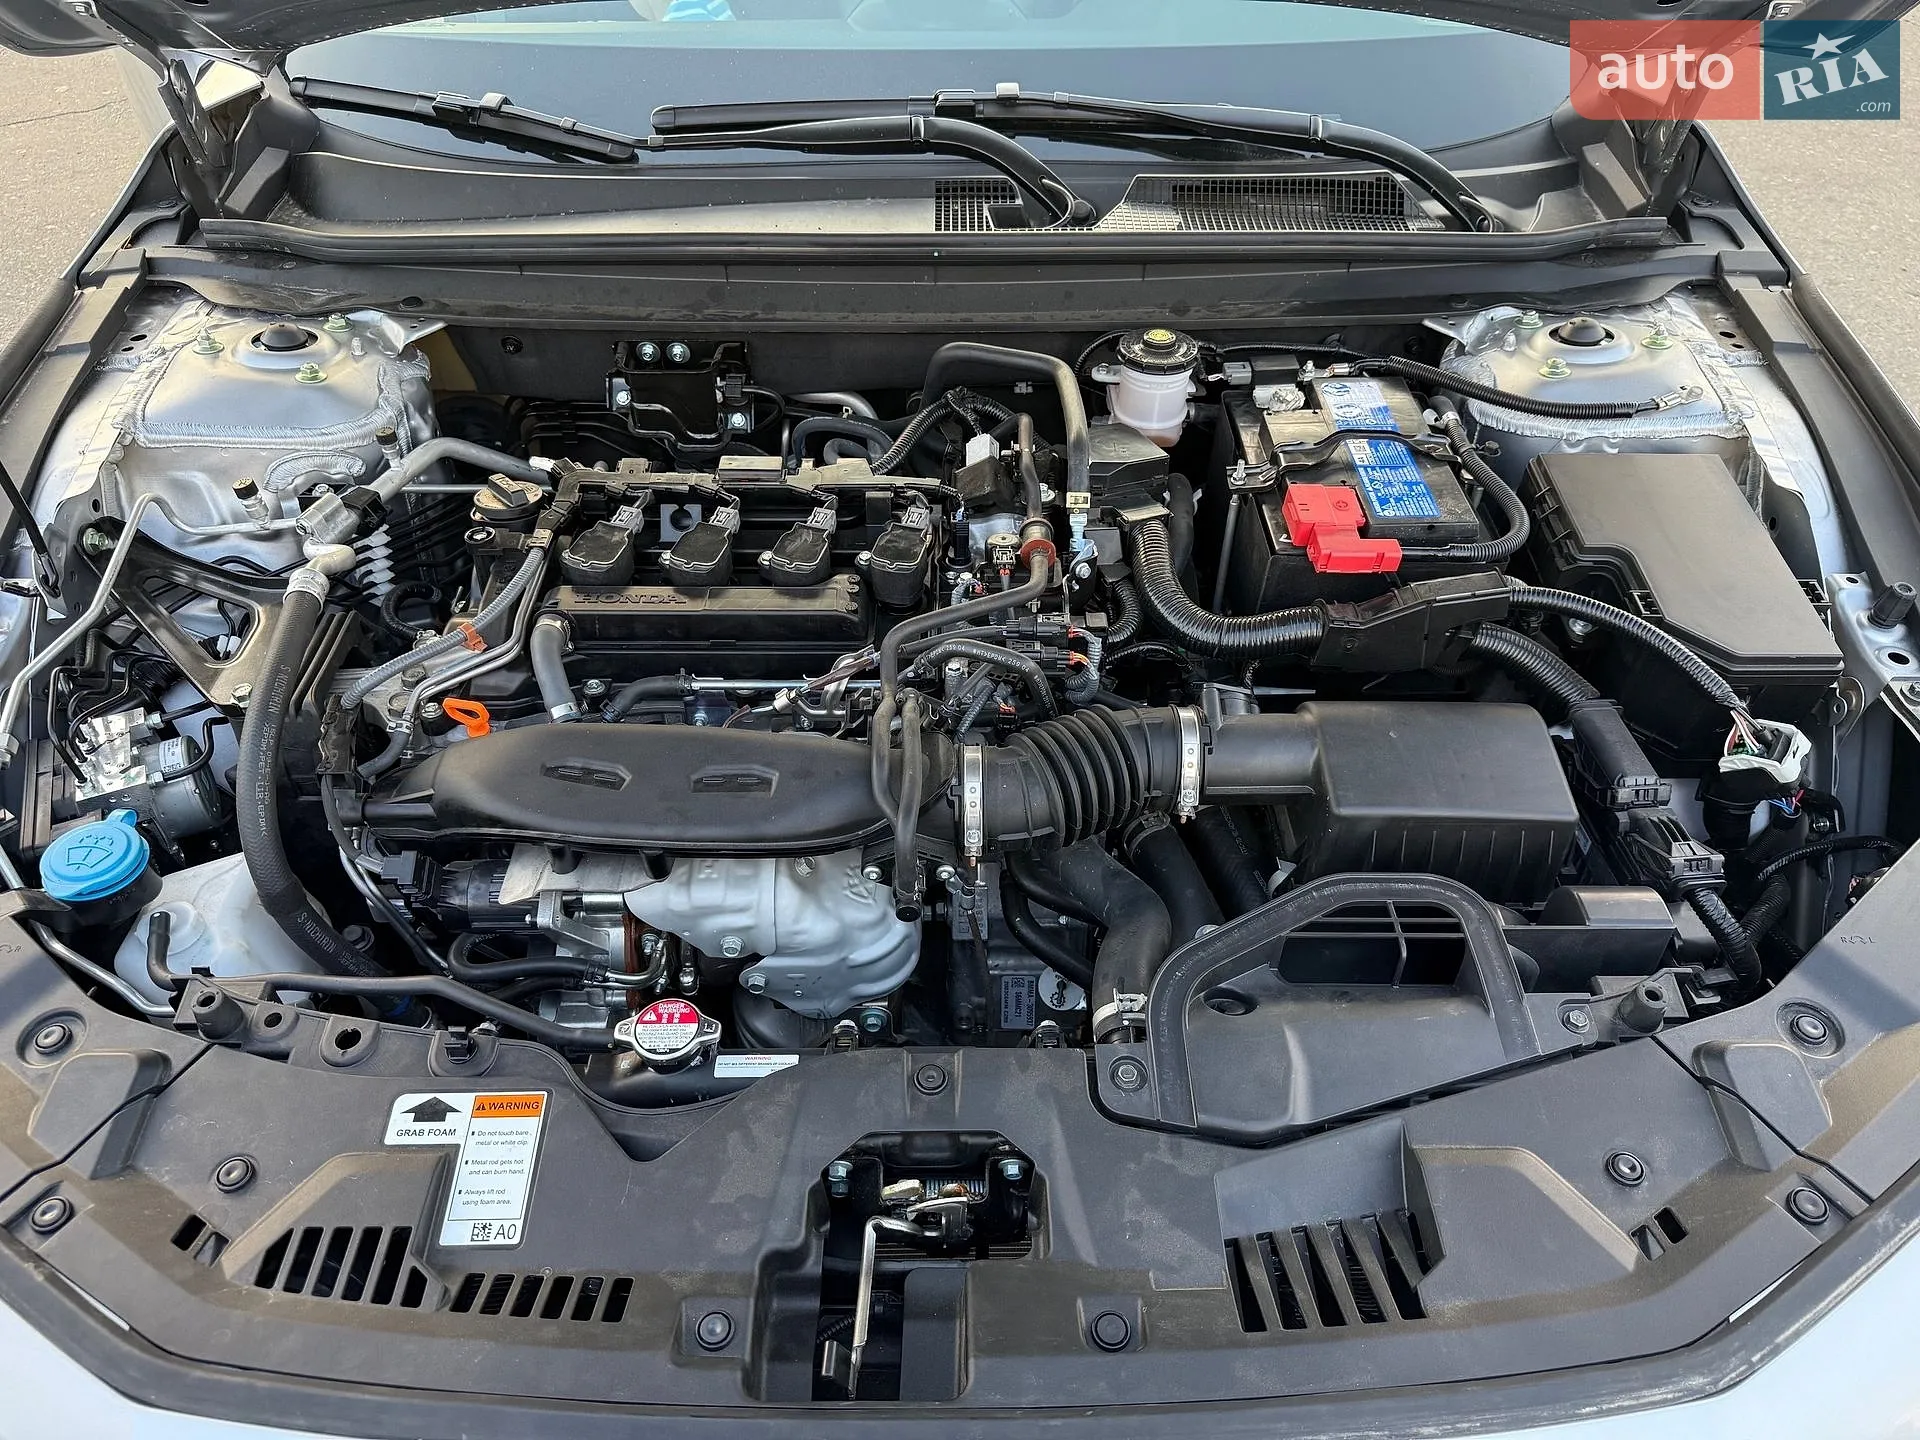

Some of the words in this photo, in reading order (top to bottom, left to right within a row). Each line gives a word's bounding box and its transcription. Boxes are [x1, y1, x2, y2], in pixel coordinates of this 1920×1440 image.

[574, 592, 687, 604] HONDA
[488, 1101, 540, 1110] WARNING
[396, 1129, 425, 1137] GRAB
[427, 1128, 457, 1136] FOAM
